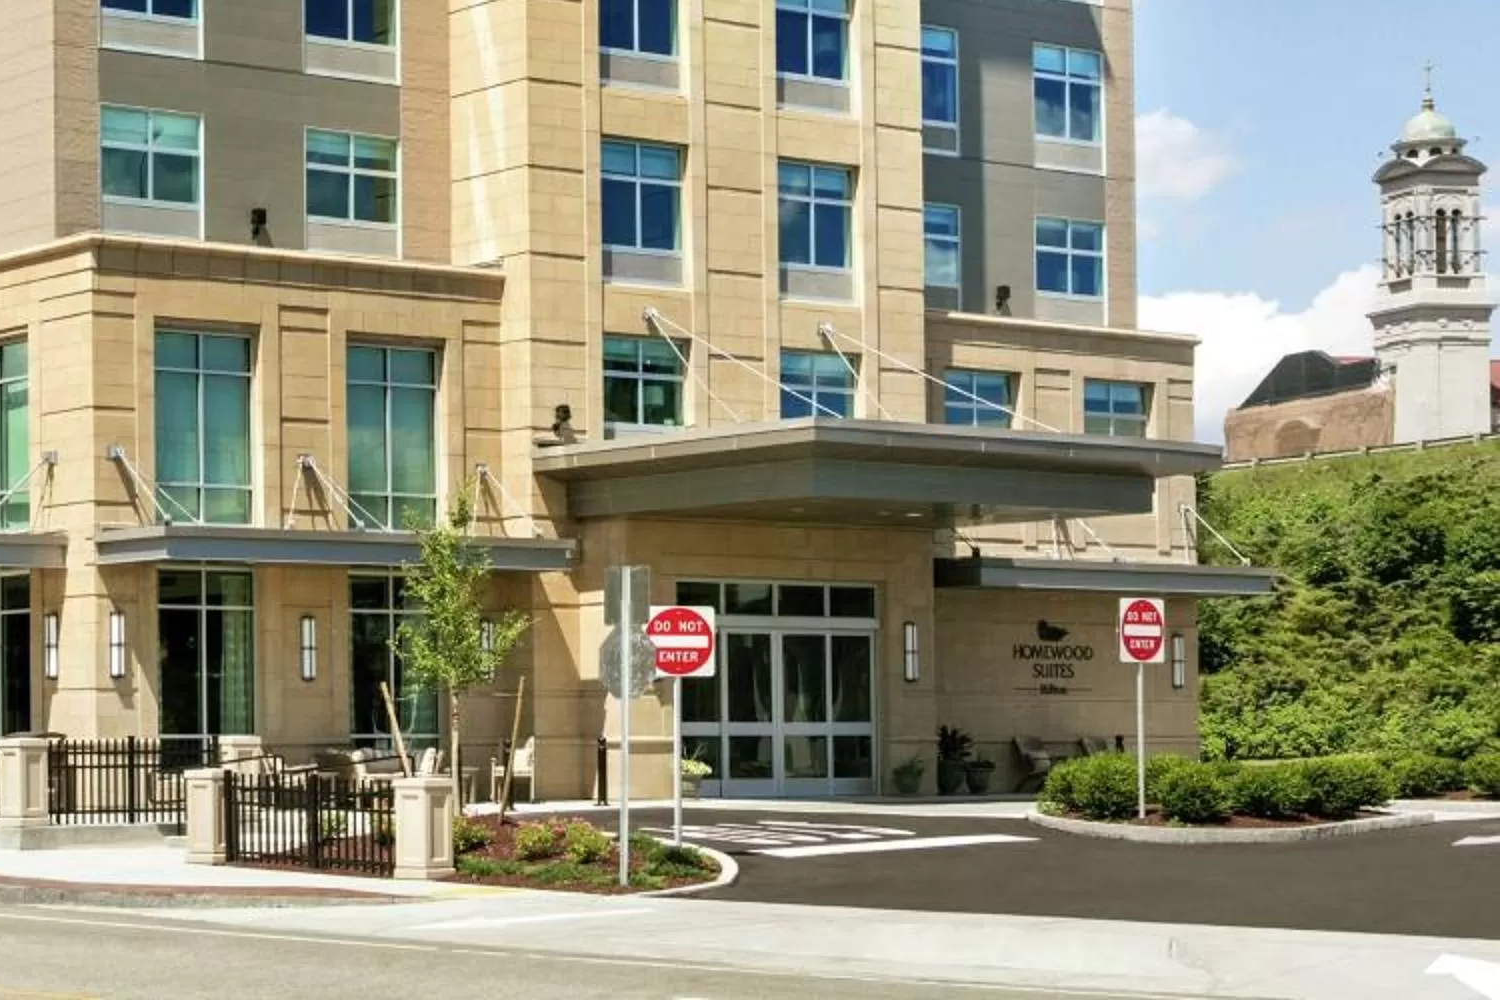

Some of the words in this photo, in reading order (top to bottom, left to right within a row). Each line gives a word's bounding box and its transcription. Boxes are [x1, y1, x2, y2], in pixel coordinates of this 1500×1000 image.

[653, 620, 671, 632] DO
[678, 620, 704, 632] NOT
[659, 651, 699, 663] ENTER
[1012, 643, 1094, 661] HOMEWOOD
[1031, 663, 1075, 680] SUITES
